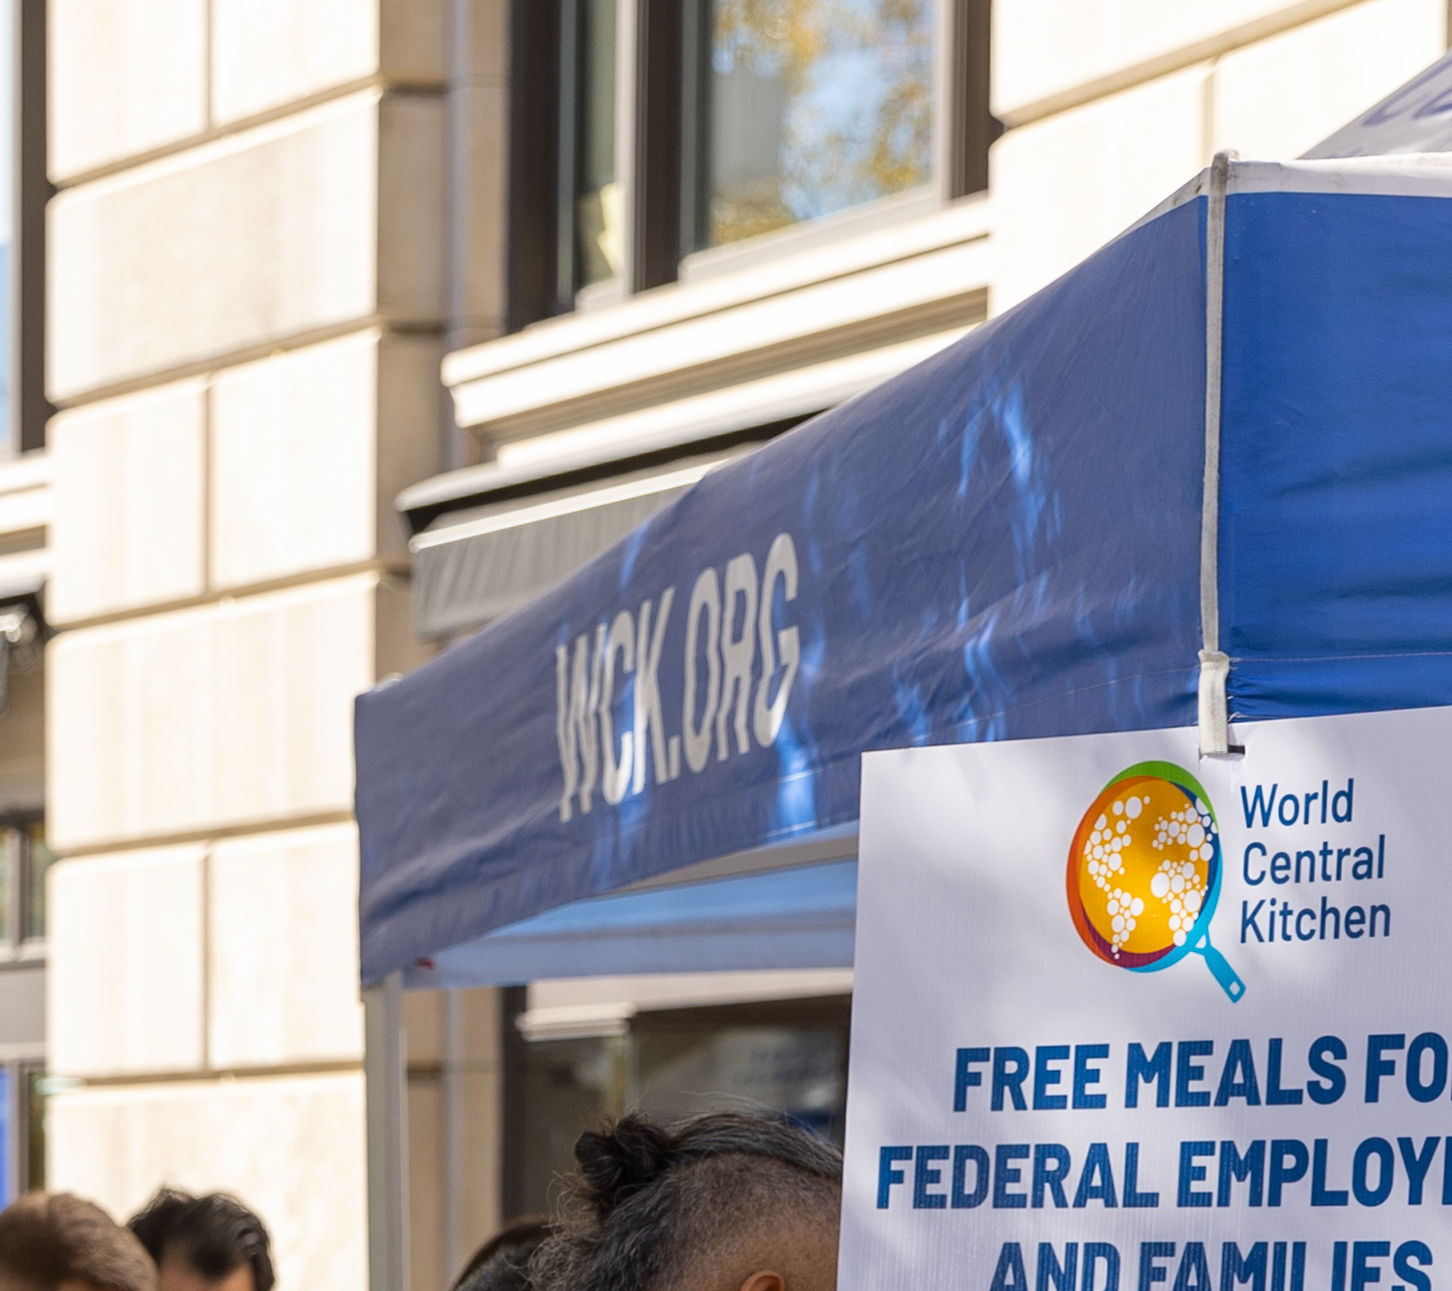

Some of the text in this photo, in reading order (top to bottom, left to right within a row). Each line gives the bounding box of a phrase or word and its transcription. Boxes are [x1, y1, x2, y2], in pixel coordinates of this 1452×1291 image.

[556, 532, 799, 823] WCK.ORG
[1240, 778, 1355, 829] World
[1242, 835, 1386, 886] Central
[1240, 896, 1392, 944] Kitchen
[952, 1043, 1110, 1113] FREE
[1124, 1034, 1348, 1109] MEALS
[875, 1141, 1160, 1211] FEDERAL
